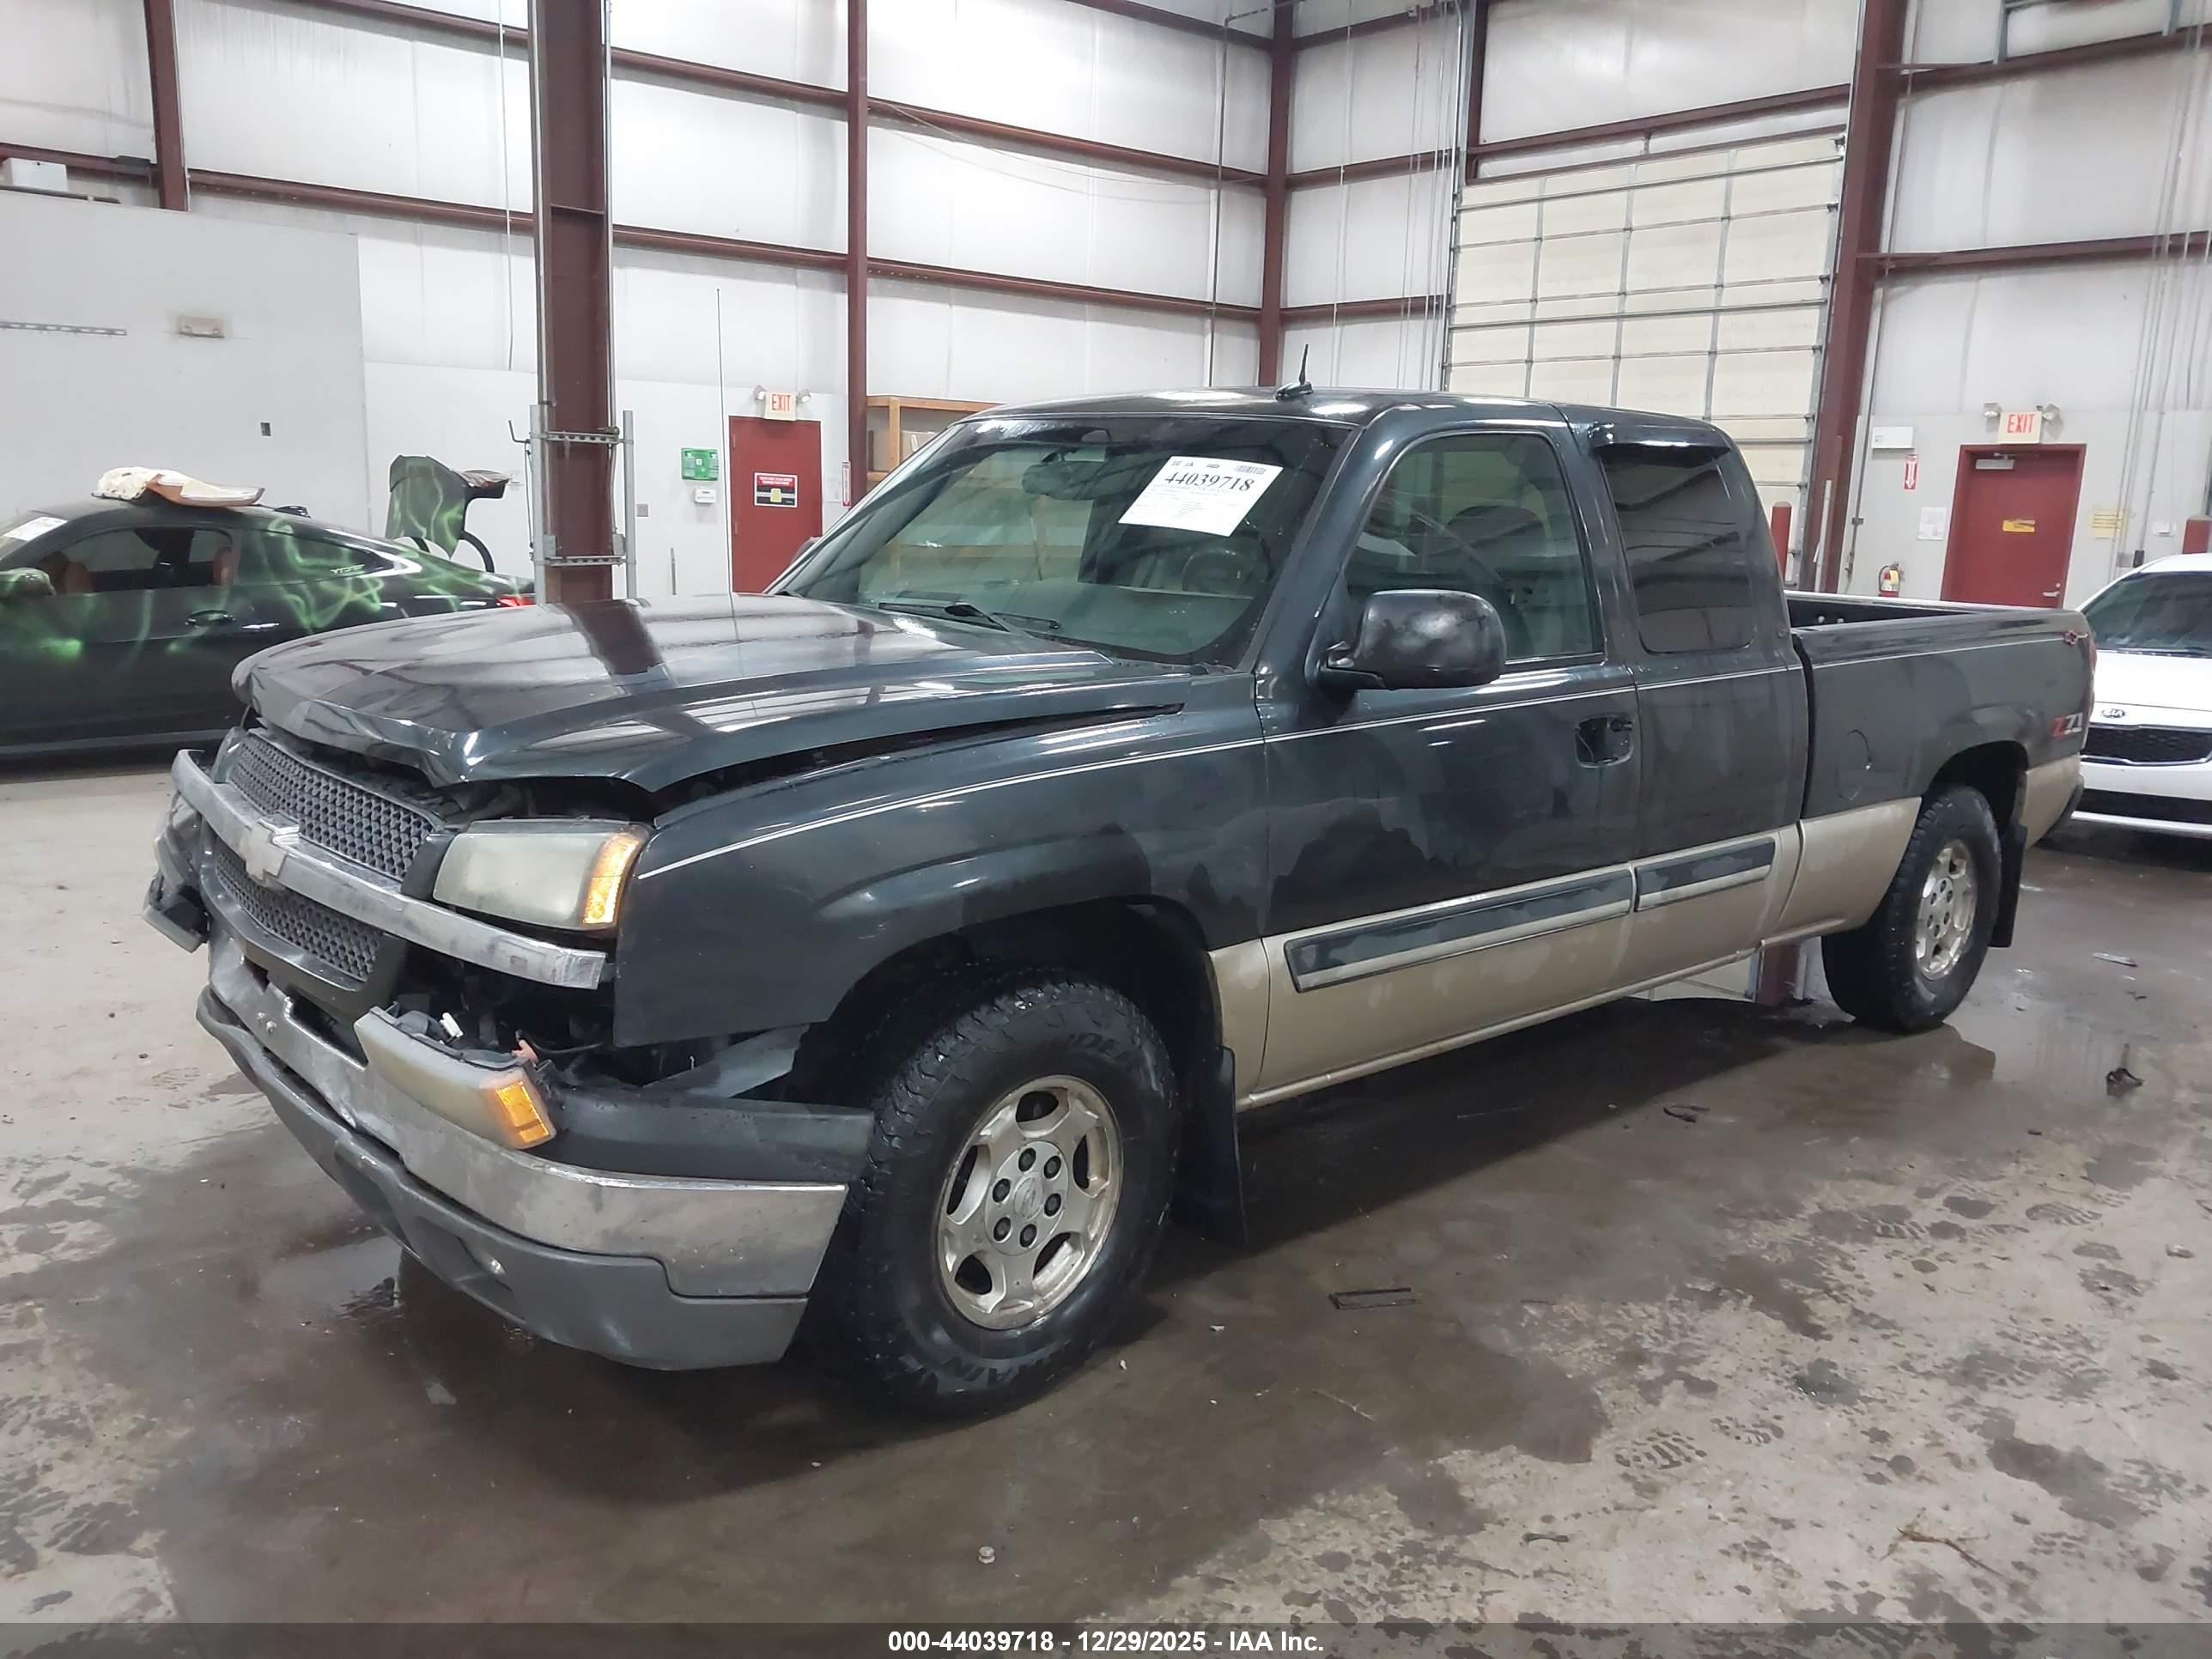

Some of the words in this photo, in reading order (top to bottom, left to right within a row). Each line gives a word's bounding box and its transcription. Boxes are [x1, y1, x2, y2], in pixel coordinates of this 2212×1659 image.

[771, 393, 791, 411] EXIT
[2007, 413, 2036, 434] EXIT
[1164, 471, 1255, 491] 44039718
[2052, 713, 2082, 738] Z71
